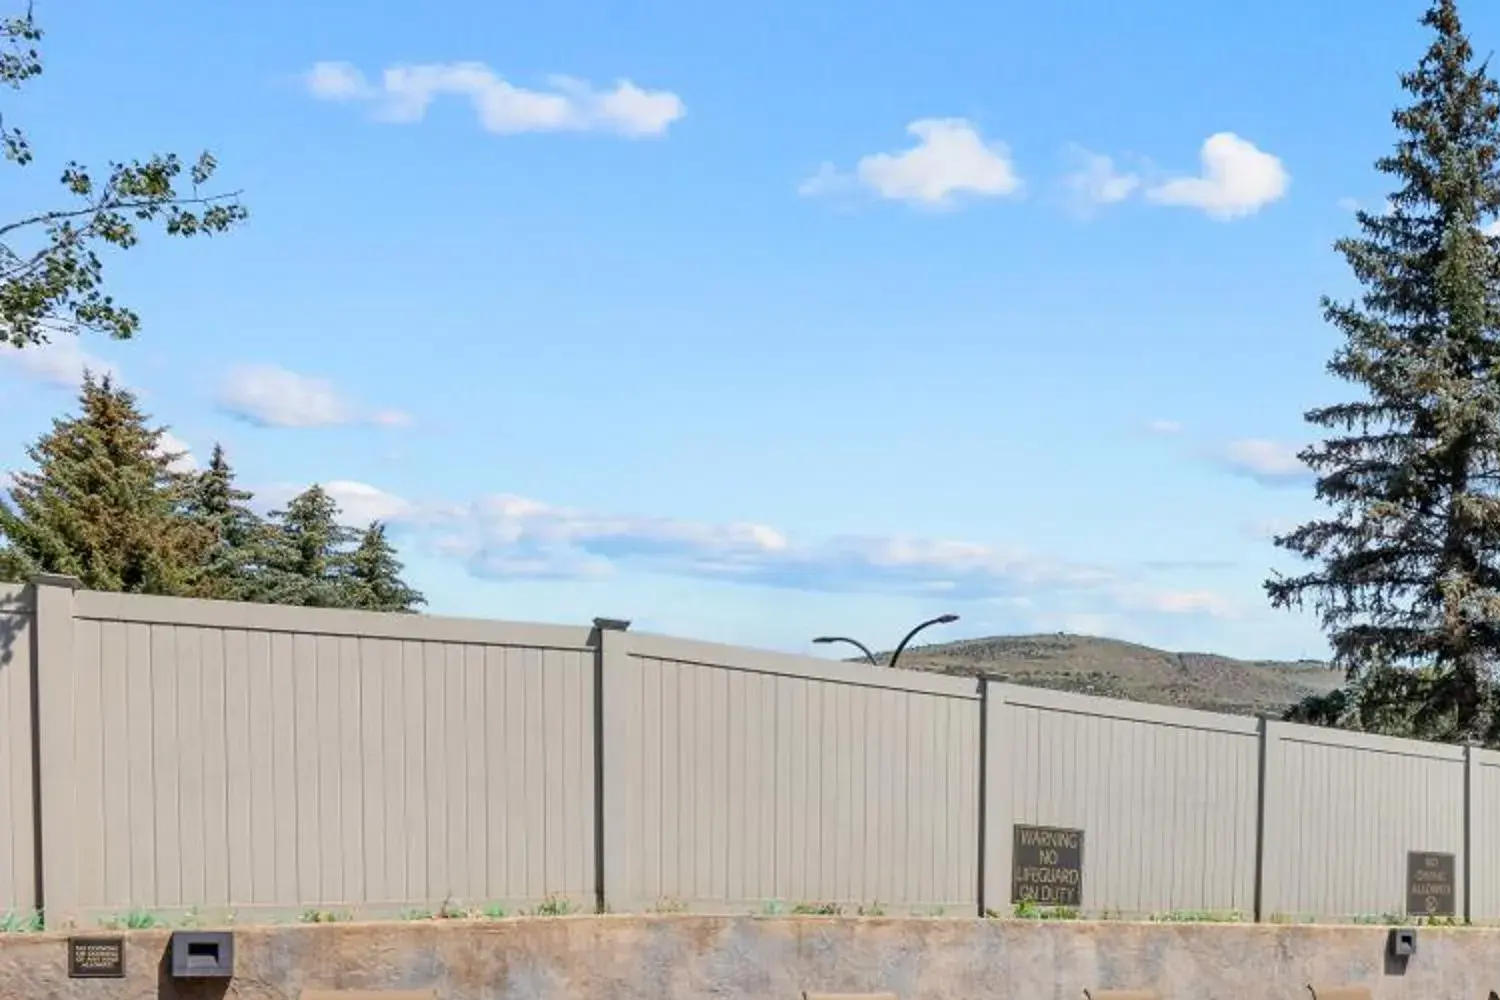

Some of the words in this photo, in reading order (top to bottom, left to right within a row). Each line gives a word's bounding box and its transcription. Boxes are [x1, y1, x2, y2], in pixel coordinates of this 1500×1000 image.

[1021, 830, 1078, 849] WARNING
[1039, 848, 1059, 865] NO
[1015, 865, 1079, 885] LIFEGUARD
[1019, 884, 1039, 900] ON
[1041, 885, 1075, 904] DUTY
